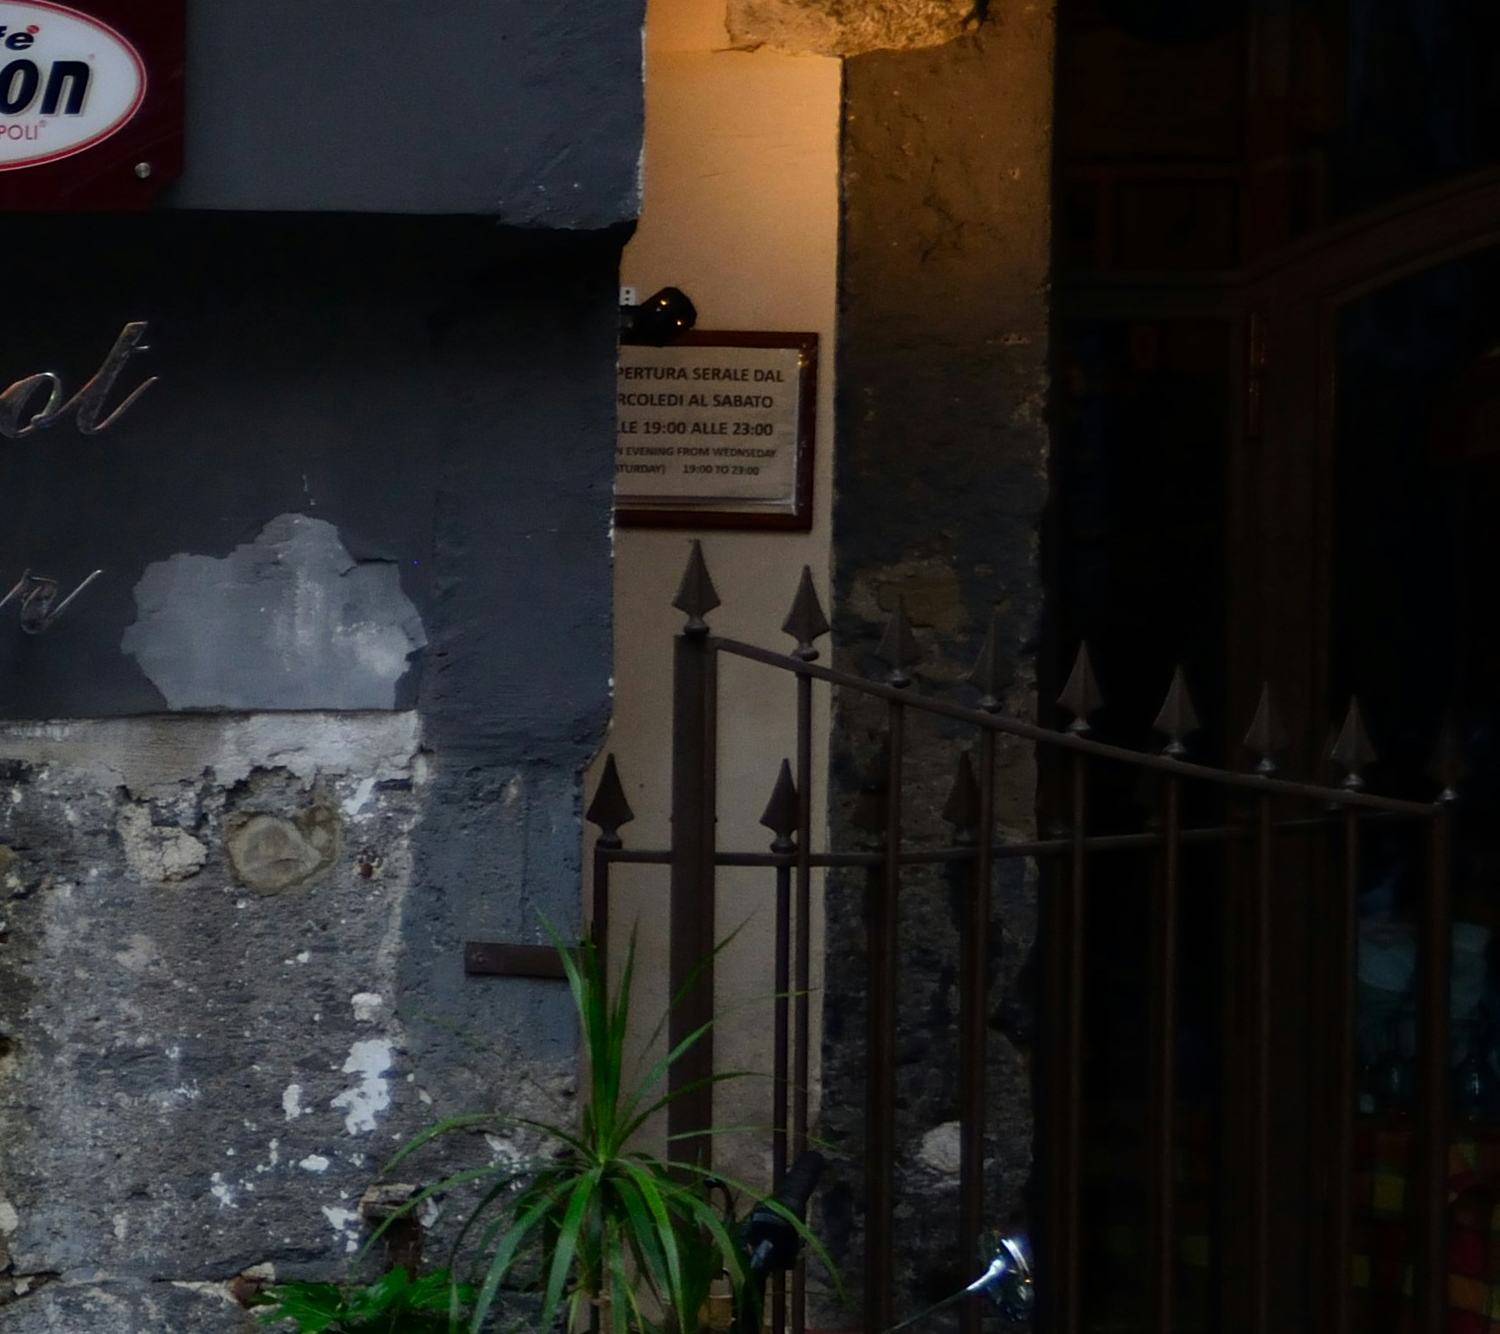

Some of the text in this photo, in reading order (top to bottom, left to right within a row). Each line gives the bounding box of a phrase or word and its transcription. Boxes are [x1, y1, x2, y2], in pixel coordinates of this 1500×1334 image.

[693, 368, 749, 382] SERALE
[754, 369, 784, 383] DAL
[689, 394, 708, 407] AL
[713, 394, 774, 409] SABATO
[643, 421, 686, 436] 19:00
[691, 422, 727, 436] ALLE
[732, 423, 774, 437] 23:00
[626, 447, 674, 457] EVENING
[677, 447, 709, 458] FROM
